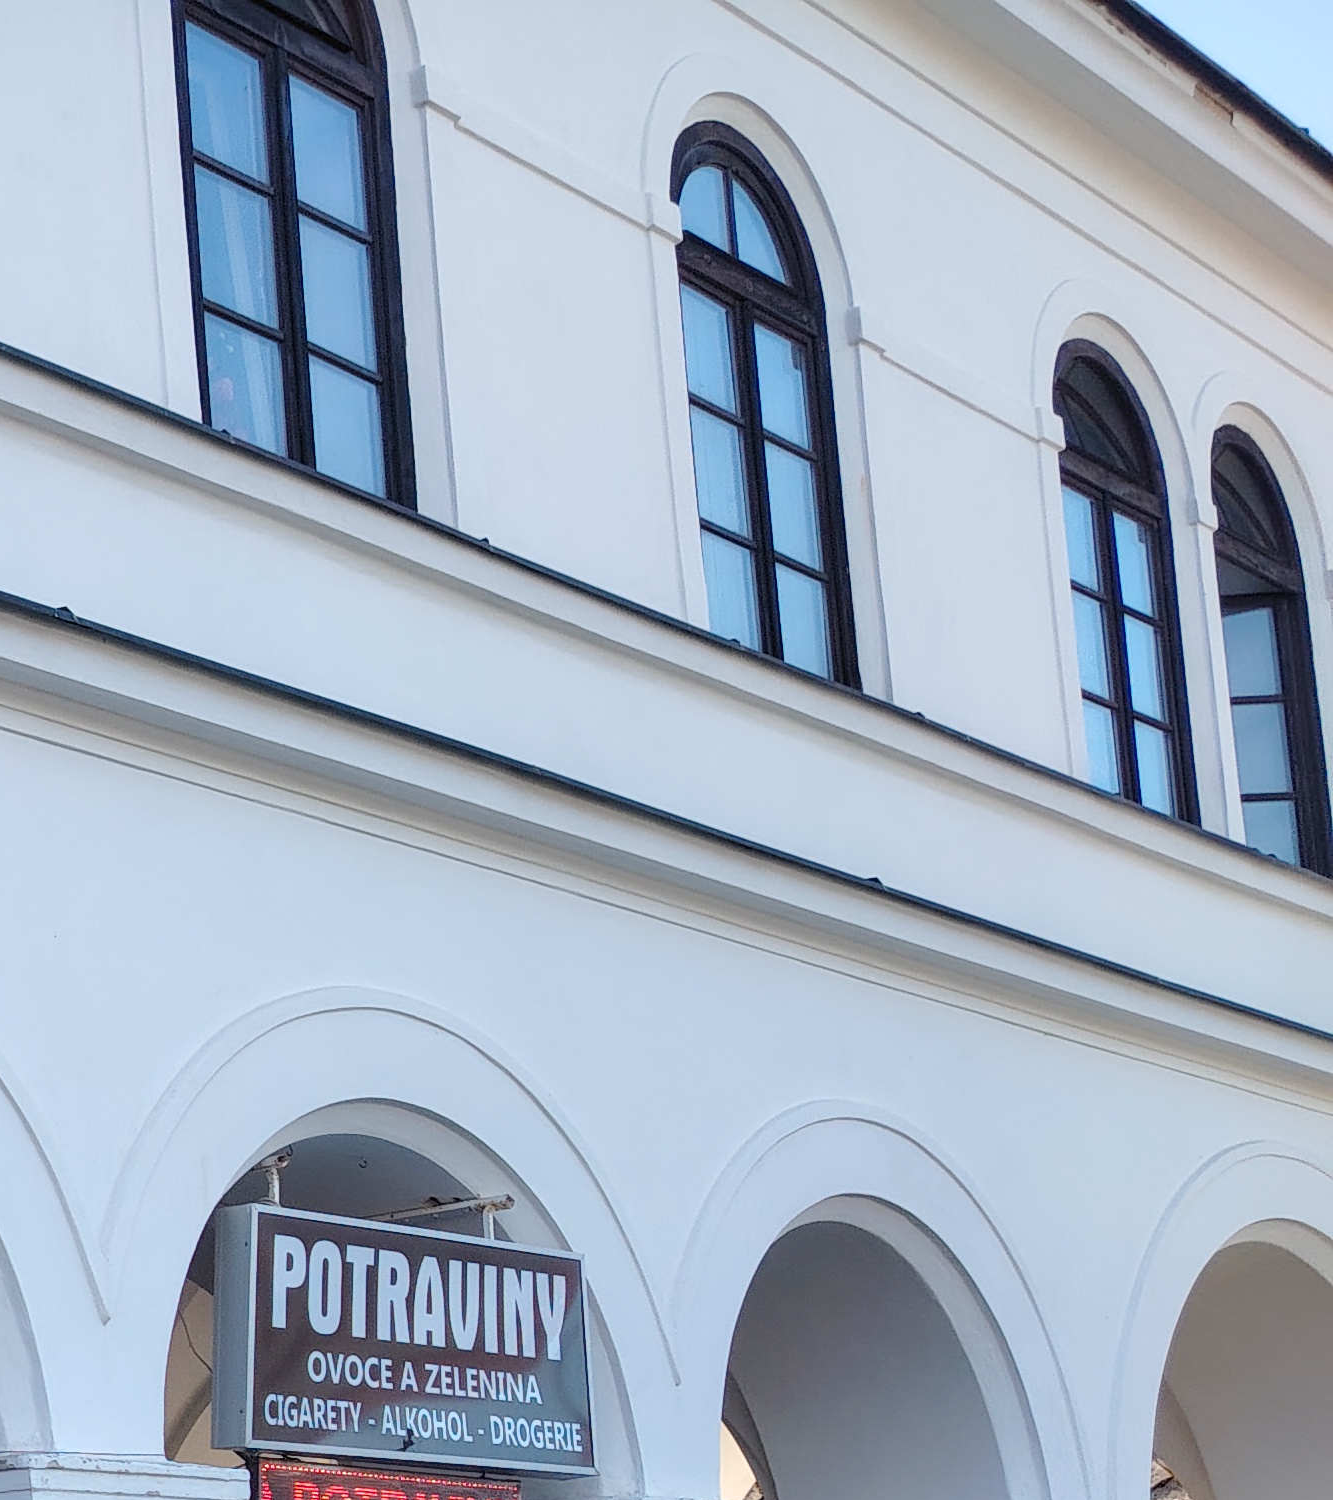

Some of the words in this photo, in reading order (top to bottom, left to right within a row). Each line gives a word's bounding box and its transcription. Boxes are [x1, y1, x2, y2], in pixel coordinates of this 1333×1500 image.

[271, 1233, 567, 1361] POTRAVINY
[307, 1350, 394, 1390] OVOCE
[400, 1361, 418, 1392] A
[425, 1363, 544, 1405] ZELENINA
[263, 1394, 363, 1433] CIGARETY
[381, 1405, 474, 1443] ALKOHOL
[490, 1415, 584, 1453] DROGERIE
